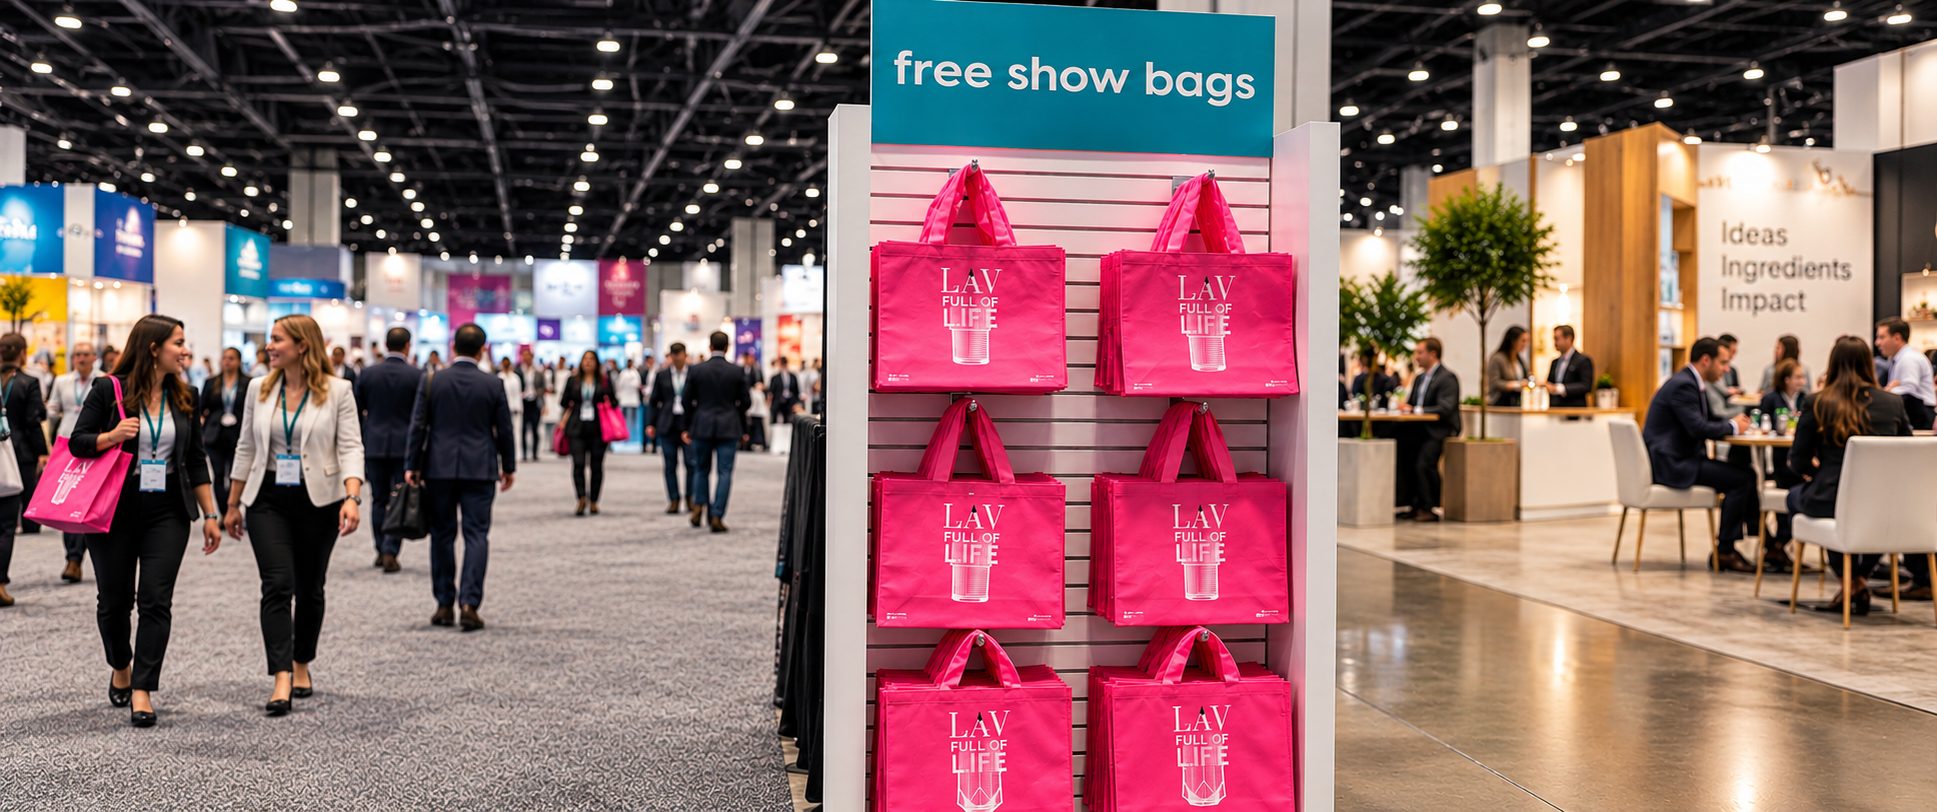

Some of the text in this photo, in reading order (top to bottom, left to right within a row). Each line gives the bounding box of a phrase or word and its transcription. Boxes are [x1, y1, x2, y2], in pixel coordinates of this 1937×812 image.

[894, 50, 1256, 107] free show bags
[1721, 220, 1788, 246] Ideas
[1721, 254, 1852, 284] Ingredients
[940, 267, 1003, 294] LAV
[1177, 274, 1236, 301] LAV
[942, 296, 998, 307] FULL OF
[1179, 303, 1232, 314] FULL OF
[1721, 288, 1806, 316] Impact
[943, 308, 998, 328] LIFE
[1180, 314, 1232, 335] LIFE
[943, 503, 1005, 530] LAV
[1172, 503, 1230, 529] LAV
[943, 532, 1000, 543] FULL OF
[1174, 532, 1226, 542] FULL OF
[944, 543, 999, 565] LIFE
[1175, 543, 1226, 562] LIFE
[948, 710, 1010, 738] LAV
[1172, 704, 1232, 732] LAV
[950, 740, 1008, 752] FULL OF
[1175, 733, 1229, 745] FULL OF
[952, 752, 1007, 774] LIFE
[1177, 745, 1230, 767] LIFE
